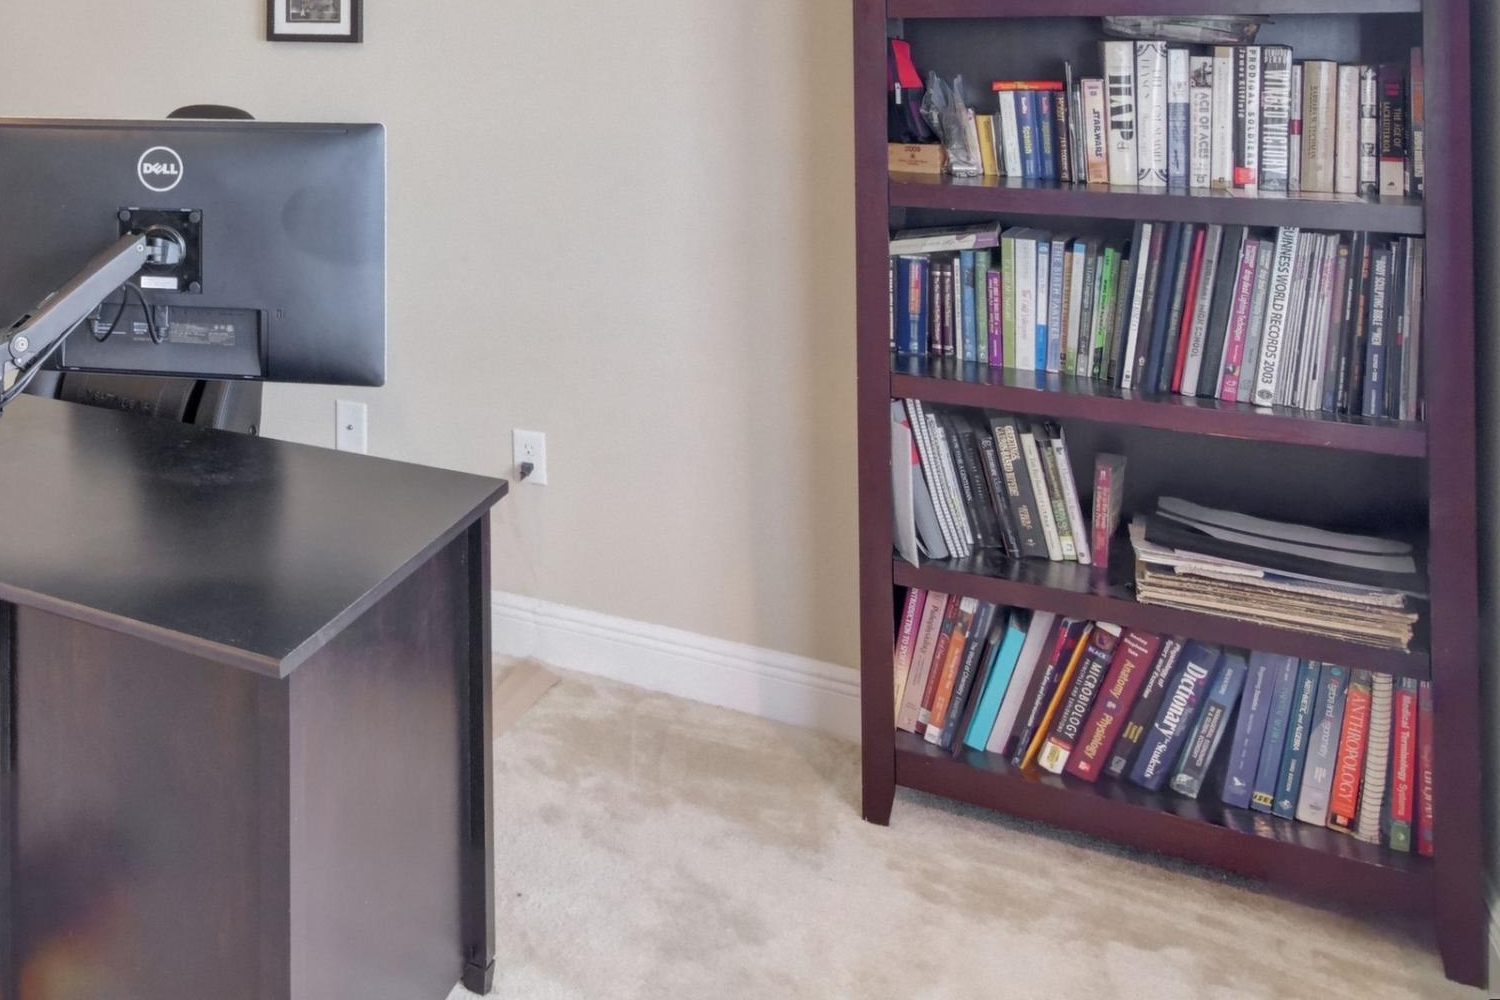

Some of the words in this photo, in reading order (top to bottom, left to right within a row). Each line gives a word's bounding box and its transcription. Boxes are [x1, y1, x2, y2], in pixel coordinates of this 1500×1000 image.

[1248, 49, 1256, 105] PRODIGAL
[1199, 93, 1209, 112] ACE
[1264, 70, 1288, 118] WINGED
[1200, 116, 1210, 130] OF
[1393, 108, 1401, 121] THE
[1022, 126, 1032, 153] Spanish
[1247, 112, 1256, 165] SOLDIERS
[1393, 123, 1401, 136] AGE
[1393, 138, 1401, 147] OF
[1094, 133, 1102, 158] WARS
[1200, 133, 1210, 159] ACES
[1262, 123, 1288, 175] VICTORY
[143, 162, 179, 176] DELL
[1053, 245, 1062, 262] THE
[1278, 227, 1296, 273] GUINNESS
[1053, 267, 1061, 295] BIRTH
[1375, 260, 1386, 276] BODY
[1236, 294, 1250, 315] Lighting
[1272, 275, 1288, 311] WORLD
[1373, 278, 1386, 308] SCULPTING
[1051, 298, 1060, 339] PARTNER
[1197, 304, 1207, 325] HIGH
[1372, 309, 1382, 325] BIBLE
[1190, 324, 1204, 359] SCHOOL
[1234, 315, 1247, 342] Techniques
[1265, 312, 1282, 359] RECORDS
[1371, 332, 1382, 345] MEN
[1262, 360, 1276, 384] 2003
[902, 587, 918, 635] INTRODUCTION
[902, 635, 911, 645] TO
[969, 641, 977, 651] The
[1161, 639, 1173, 658] Sport
[964, 651, 974, 665] World
[1074, 658, 1090, 685] PRINCIPLES
[1154, 658, 1166, 670] and
[1160, 642, 1181, 680] Physiology
[955, 671, 969, 696] Chemistry
[1071, 686, 1079, 697] AND
[1109, 659, 1135, 699] Anatomy
[1143, 670, 1160, 699] Exercise
[1064, 662, 1103, 740] MICROBIOLOGY
[1106, 701, 1117, 710] &
[1154, 661, 1208, 739] Dictionary
[1298, 678, 1312, 714] ARITHMETIC
[1401, 695, 1411, 729] Medical
[1084, 713, 1113, 759] Physiology
[1192, 735, 1205, 759] ECONOMY
[1292, 724, 1303, 751] ALGEBRA
[1338, 694, 1366, 804] ANTHROPOLOGY
[1144, 742, 1166, 779] Students
[1196, 739, 1210, 767] ECONOMICS
[1398, 731, 1410, 782] Terminology
[1397, 783, 1407, 816] Systems
